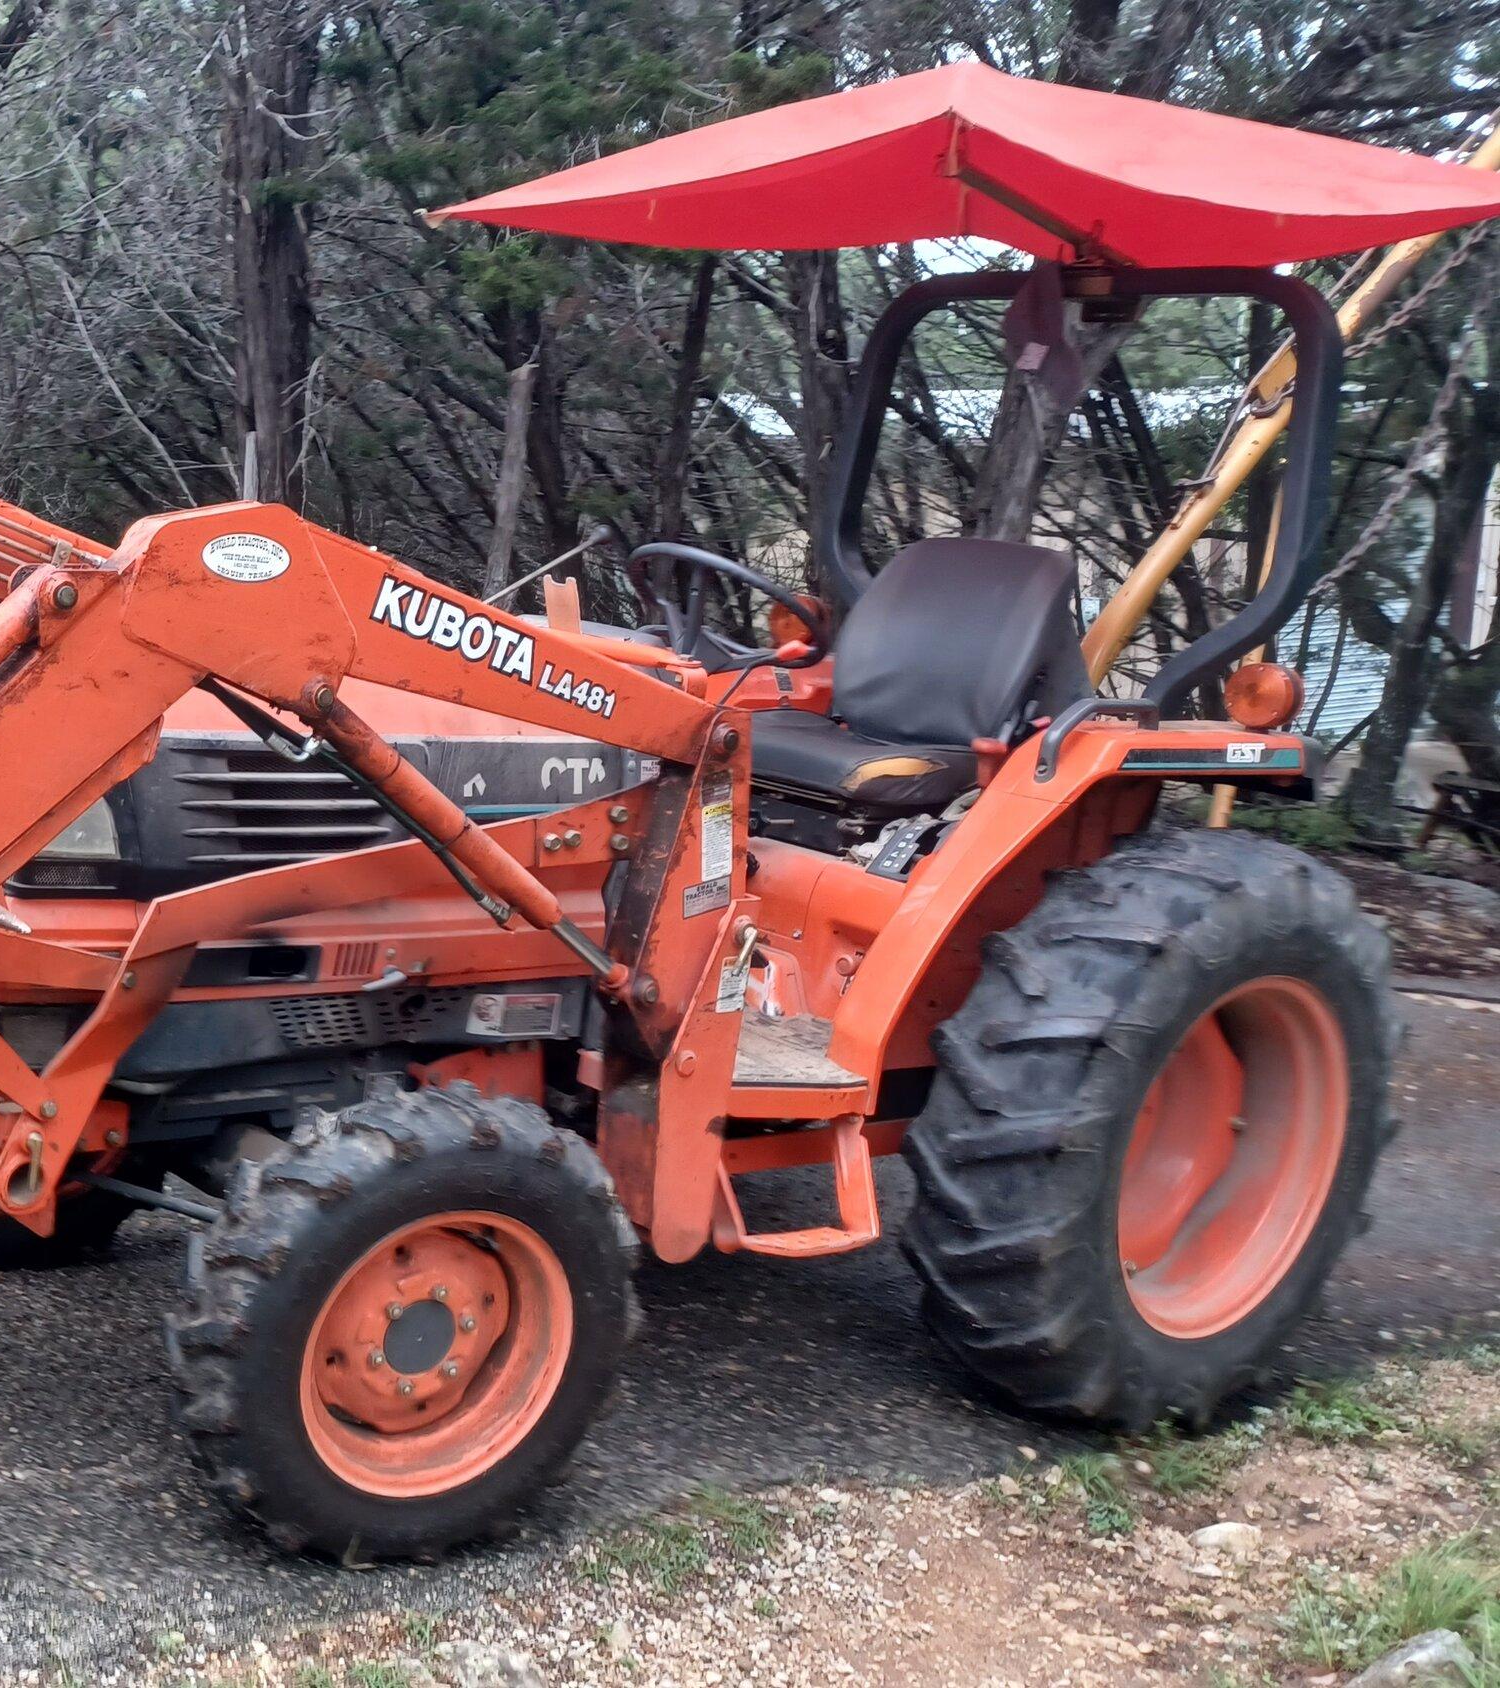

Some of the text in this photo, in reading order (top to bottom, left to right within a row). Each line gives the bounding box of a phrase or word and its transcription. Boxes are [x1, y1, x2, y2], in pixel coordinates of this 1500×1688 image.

[247, 570, 273, 579] TEXAS
[371, 574, 536, 684] KUBOTA
[538, 662, 617, 718] LA481
[1226, 742, 1266, 763] GST
